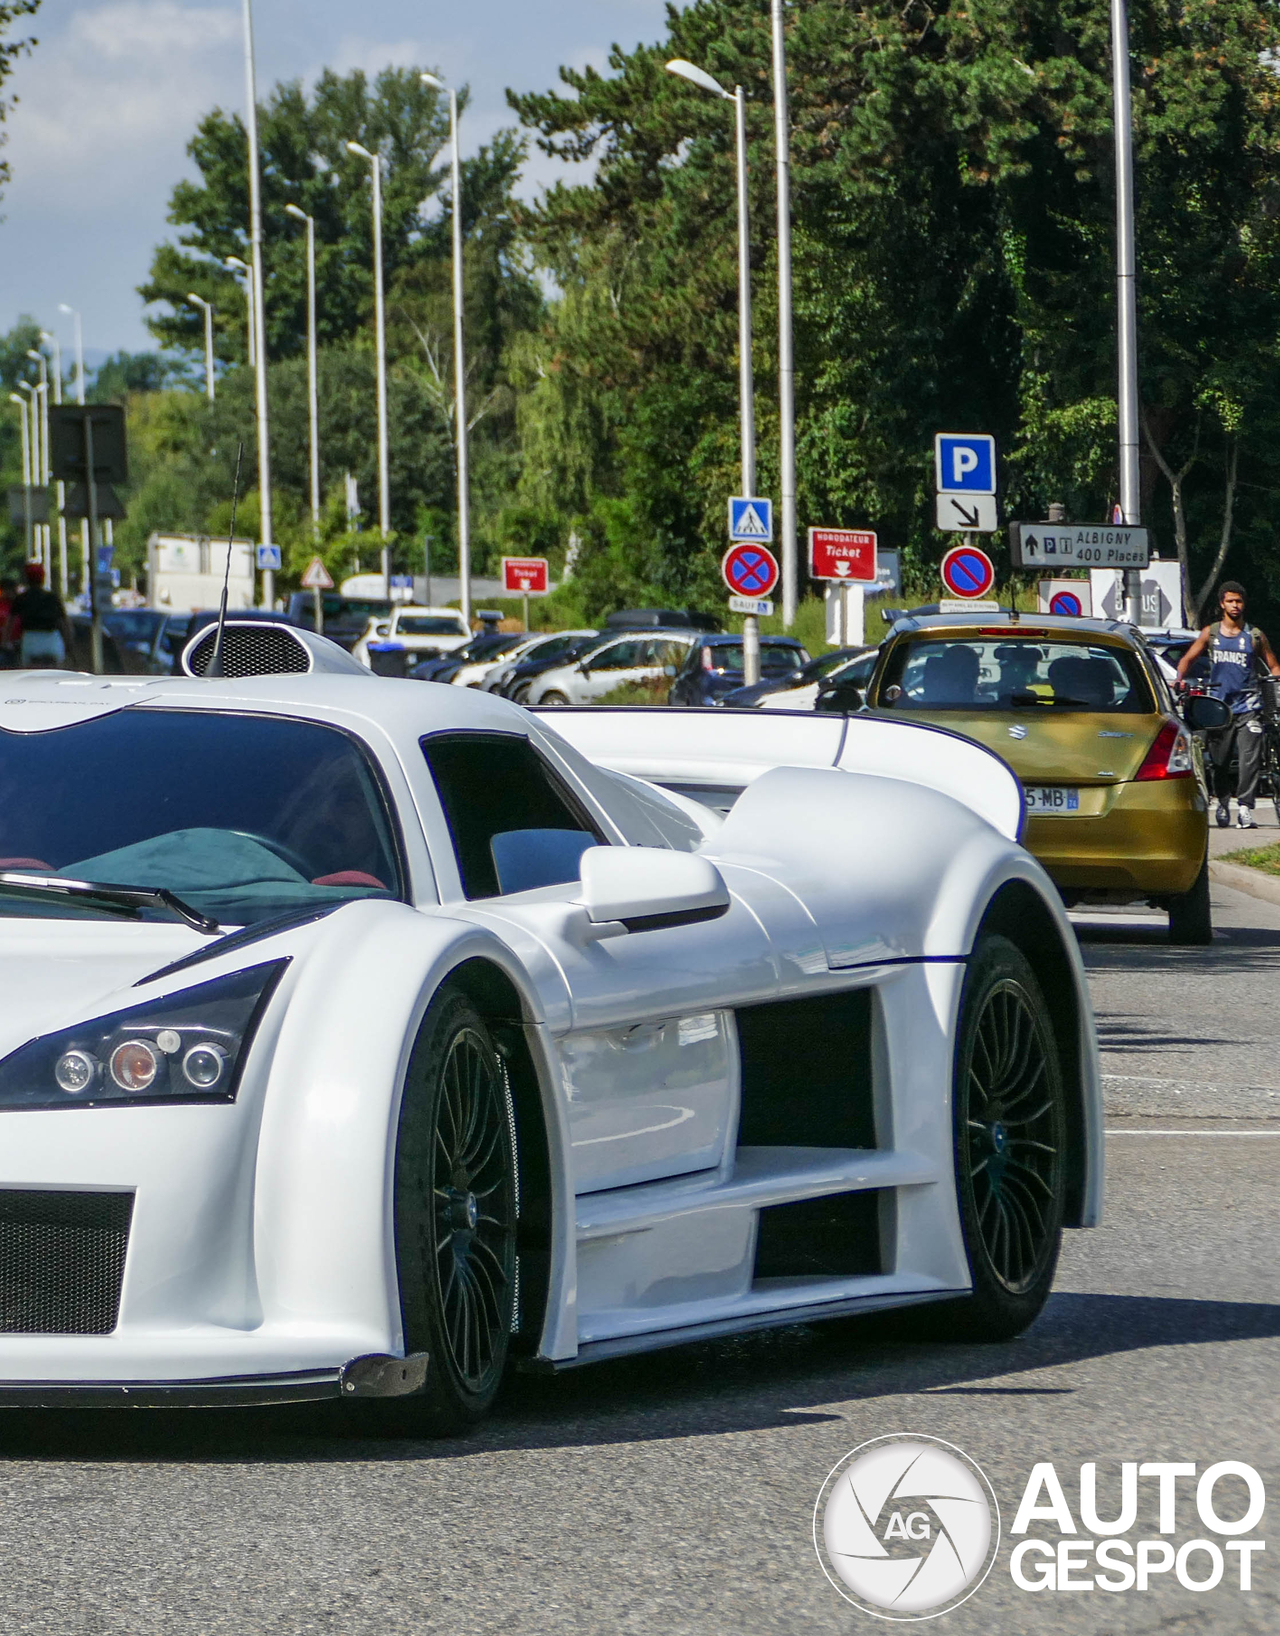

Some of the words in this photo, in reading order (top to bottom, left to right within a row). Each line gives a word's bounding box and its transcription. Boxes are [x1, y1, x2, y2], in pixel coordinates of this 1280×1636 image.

[953, 446, 978, 482] P
[817, 533, 870, 544] HORODATEUR
[1077, 532, 1131, 545] ALBIGNY
[826, 546, 861, 558] Ticket
[1077, 549, 1101, 561] 400
[1108, 551, 1144, 562] Places
[1213, 650, 1247, 667] FRANCE
